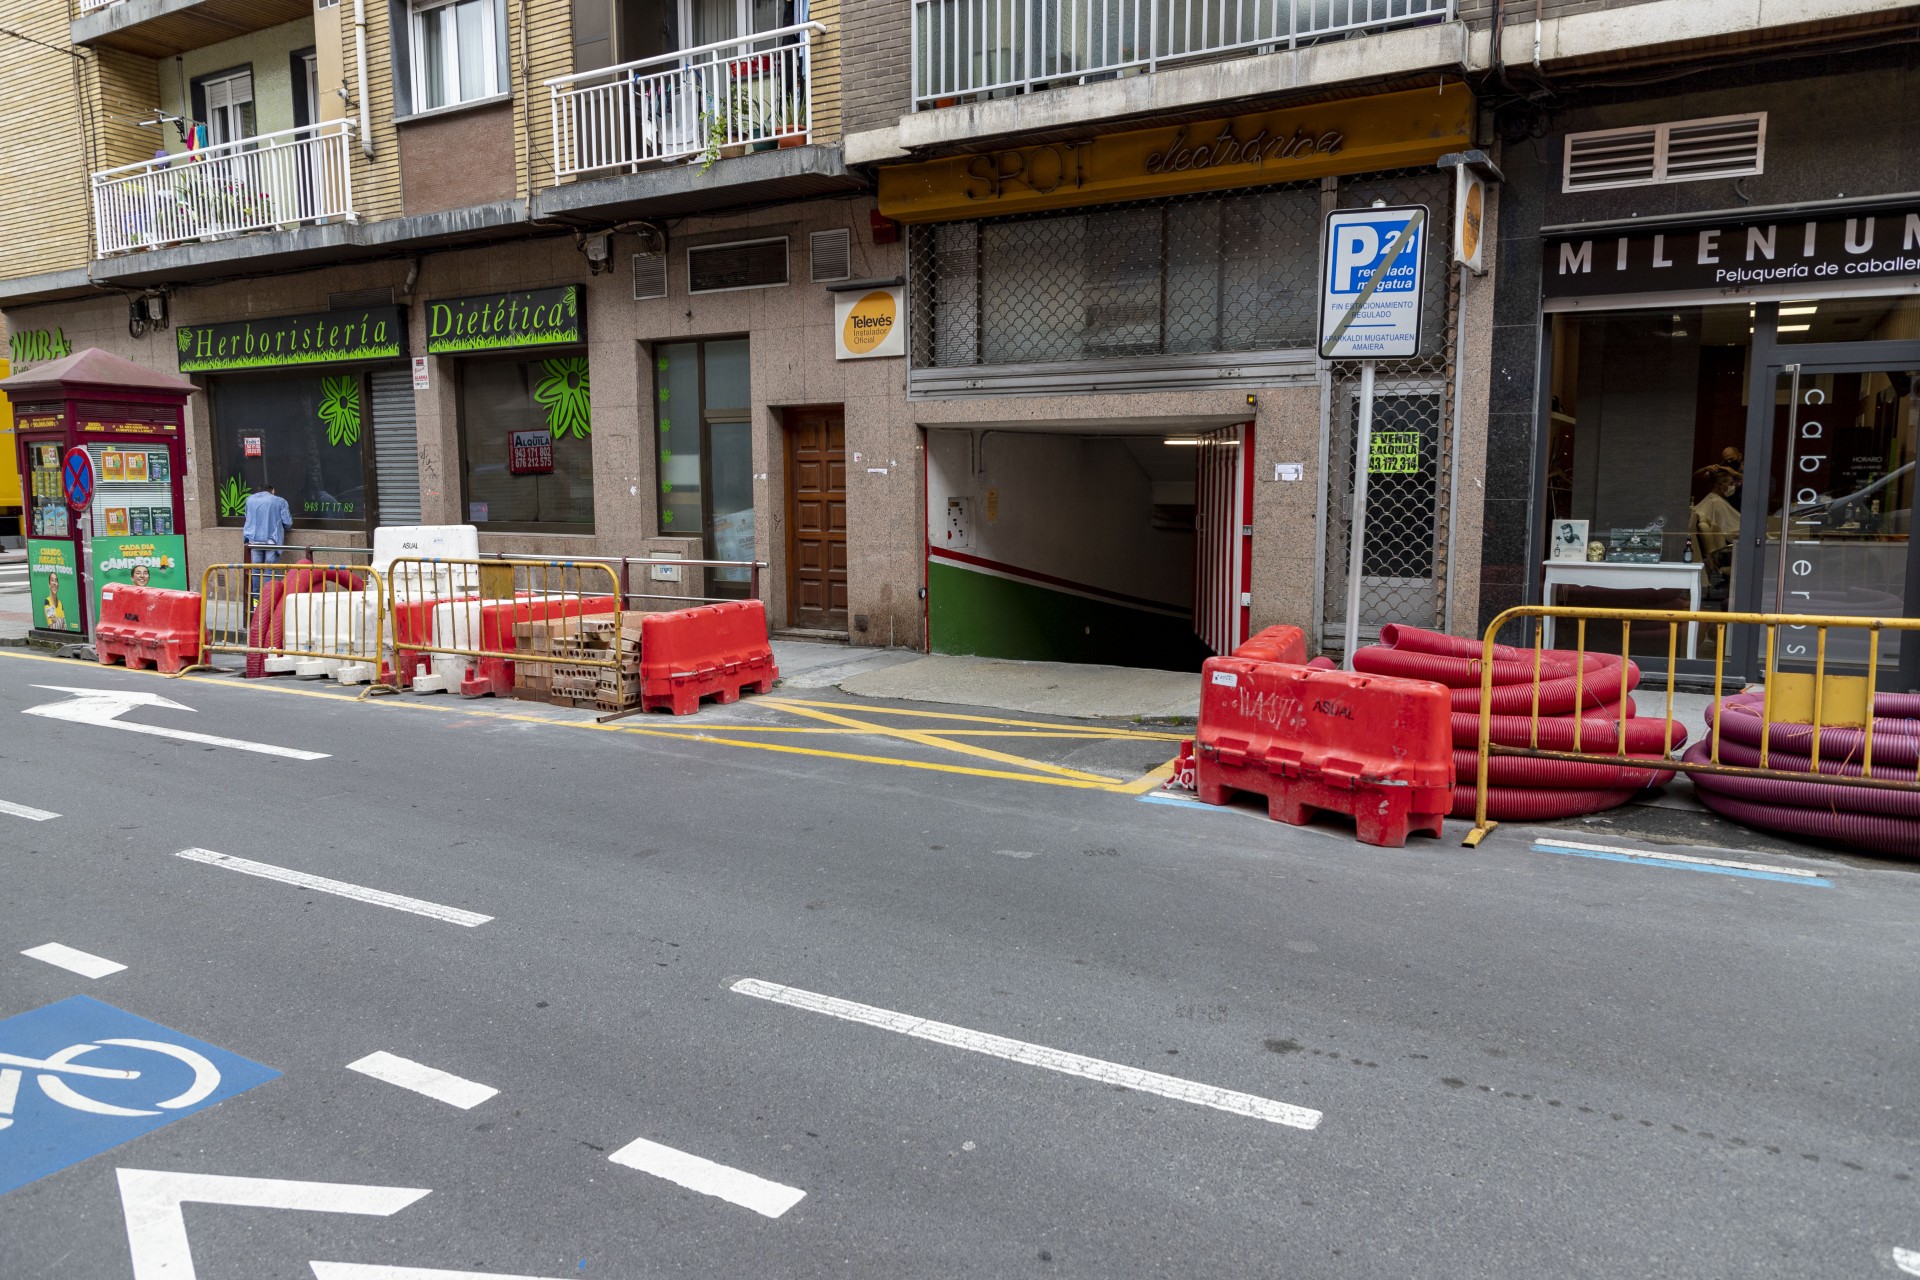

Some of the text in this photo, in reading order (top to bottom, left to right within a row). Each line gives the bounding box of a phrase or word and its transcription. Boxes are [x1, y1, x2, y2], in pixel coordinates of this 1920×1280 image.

[966, 123, 1344, 201] SPOT electrónica
[1334, 225, 1379, 291] P
[1357, 265, 1414, 277] relado
[1716, 262, 1808, 283] Peluquería
[1814, 261, 1839, 275] de
[1357, 279, 1412, 292] mgatua
[1344, 301, 1414, 310] ESTACIONAMIENTO
[430, 294, 564, 337] Dietética
[851, 313, 893, 329] Televés
[1351, 311, 1392, 319] REGULADO
[195, 313, 387, 358] Herboristería
[853, 328, 887, 337] Instalador
[1364, 333, 1415, 342] MUGATUAREN
[11, 326, 69, 362] NURA
[853, 336, 875, 345] Oficial
[515, 435, 550, 447] ALQUILA
[1381, 433, 1418, 444] VENDE
[515, 446, 551, 458] 943 171 802
[1377, 445, 1417, 455] ALQUILA
[515, 456, 552, 468] 676 212 575
[1369, 457, 1381, 470] 43
[304, 502, 354, 513] 943 17 17 82
[1786, 388, 1827, 655] caballers
[40, 548, 61, 556] CUANDO
[100, 555, 175, 572] CAMPEONAS
[55, 565, 73, 575] TODOS
[1312, 700, 1355, 720] ASUAL
